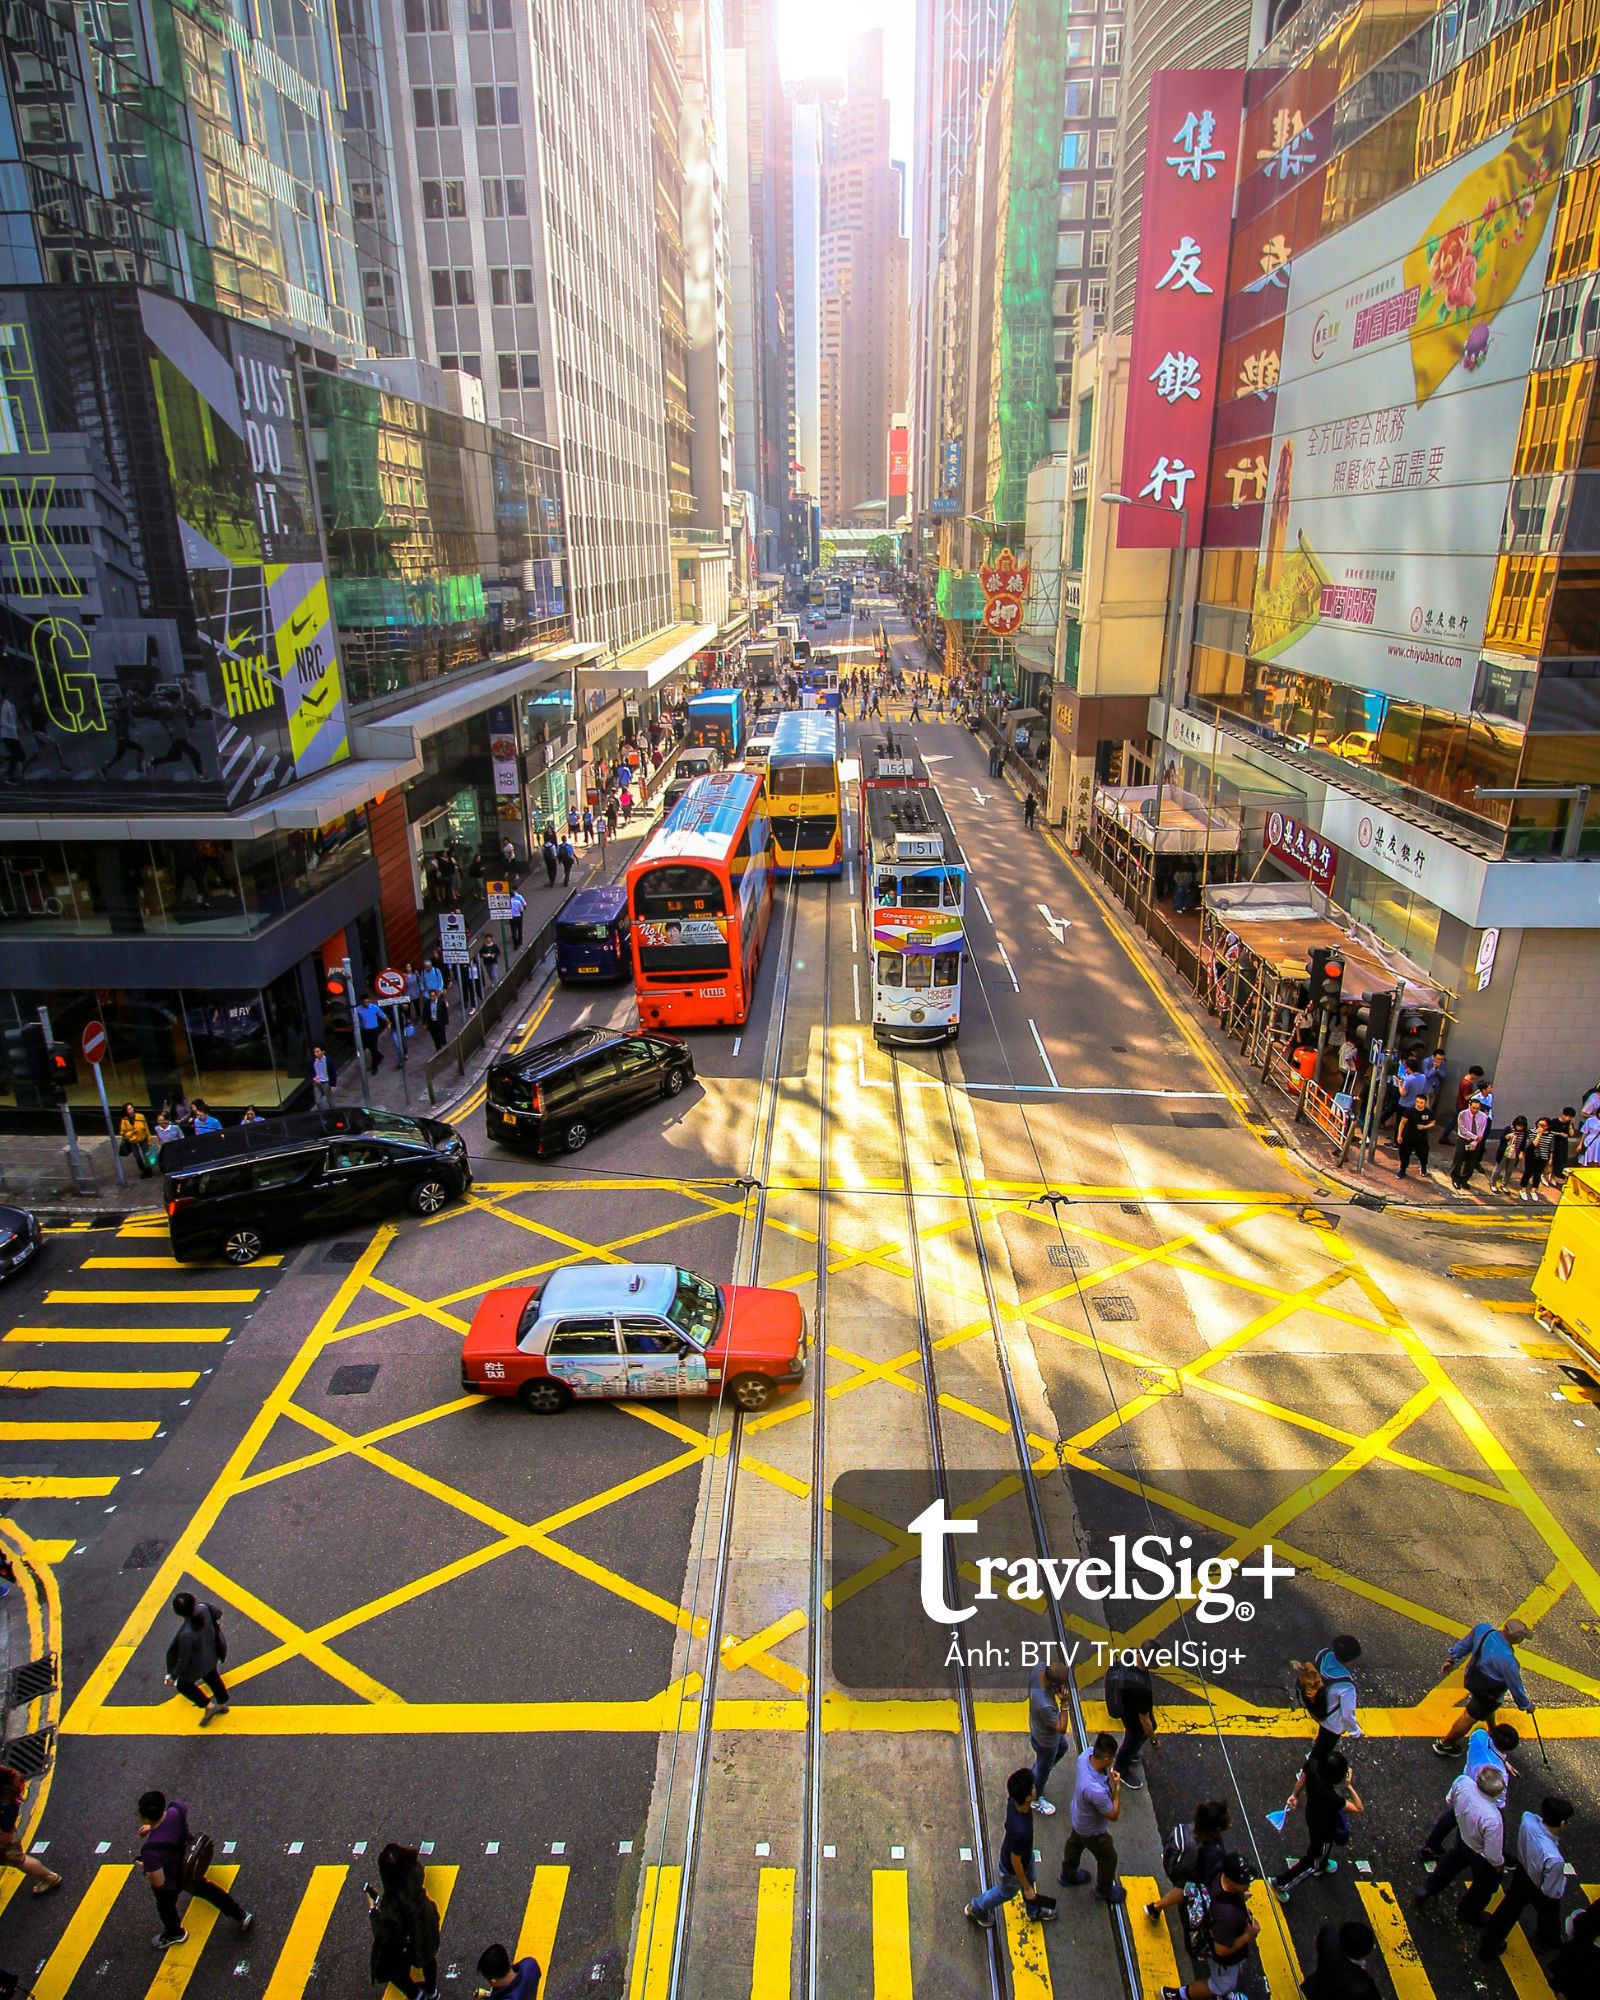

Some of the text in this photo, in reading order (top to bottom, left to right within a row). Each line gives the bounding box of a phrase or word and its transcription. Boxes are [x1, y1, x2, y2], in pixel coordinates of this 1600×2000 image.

[1138, 109, 1226, 512] 集友銀行
[1353, 286, 1420, 348] 財富管理
[239, 355, 296, 420] JUST
[246, 419, 282, 476] DO
[1306, 407, 1407, 457] 全方位綜合服務
[1332, 446, 1446, 492] 照顧您全面需要
[255, 482, 289, 535] IT.
[989, 600, 1018, 630] 押
[1319, 588, 1377, 625] 工商服務
[1424, 610, 1469, 632] 集友銀行
[295, 644, 326, 684] NRC
[1387, 644, 1462, 669] www.chiyubank.com
[221, 654, 276, 719] HKG
[886, 764, 905, 774] 152
[909, 841, 932, 855] 151
[1283, 820, 1331, 870] 集友銀行
[1375, 826, 1426, 872] 集友銀行
[638, 923, 662, 935] No.1
[882, 912, 912, 920] CONNECT
[647, 933, 668, 946] 英文
[700, 987, 727, 998] KMB
[947, 1026, 957, 1034] 151
[484, 1361, 504, 1371] 的士
[486, 1370, 505, 1379] TAXI
